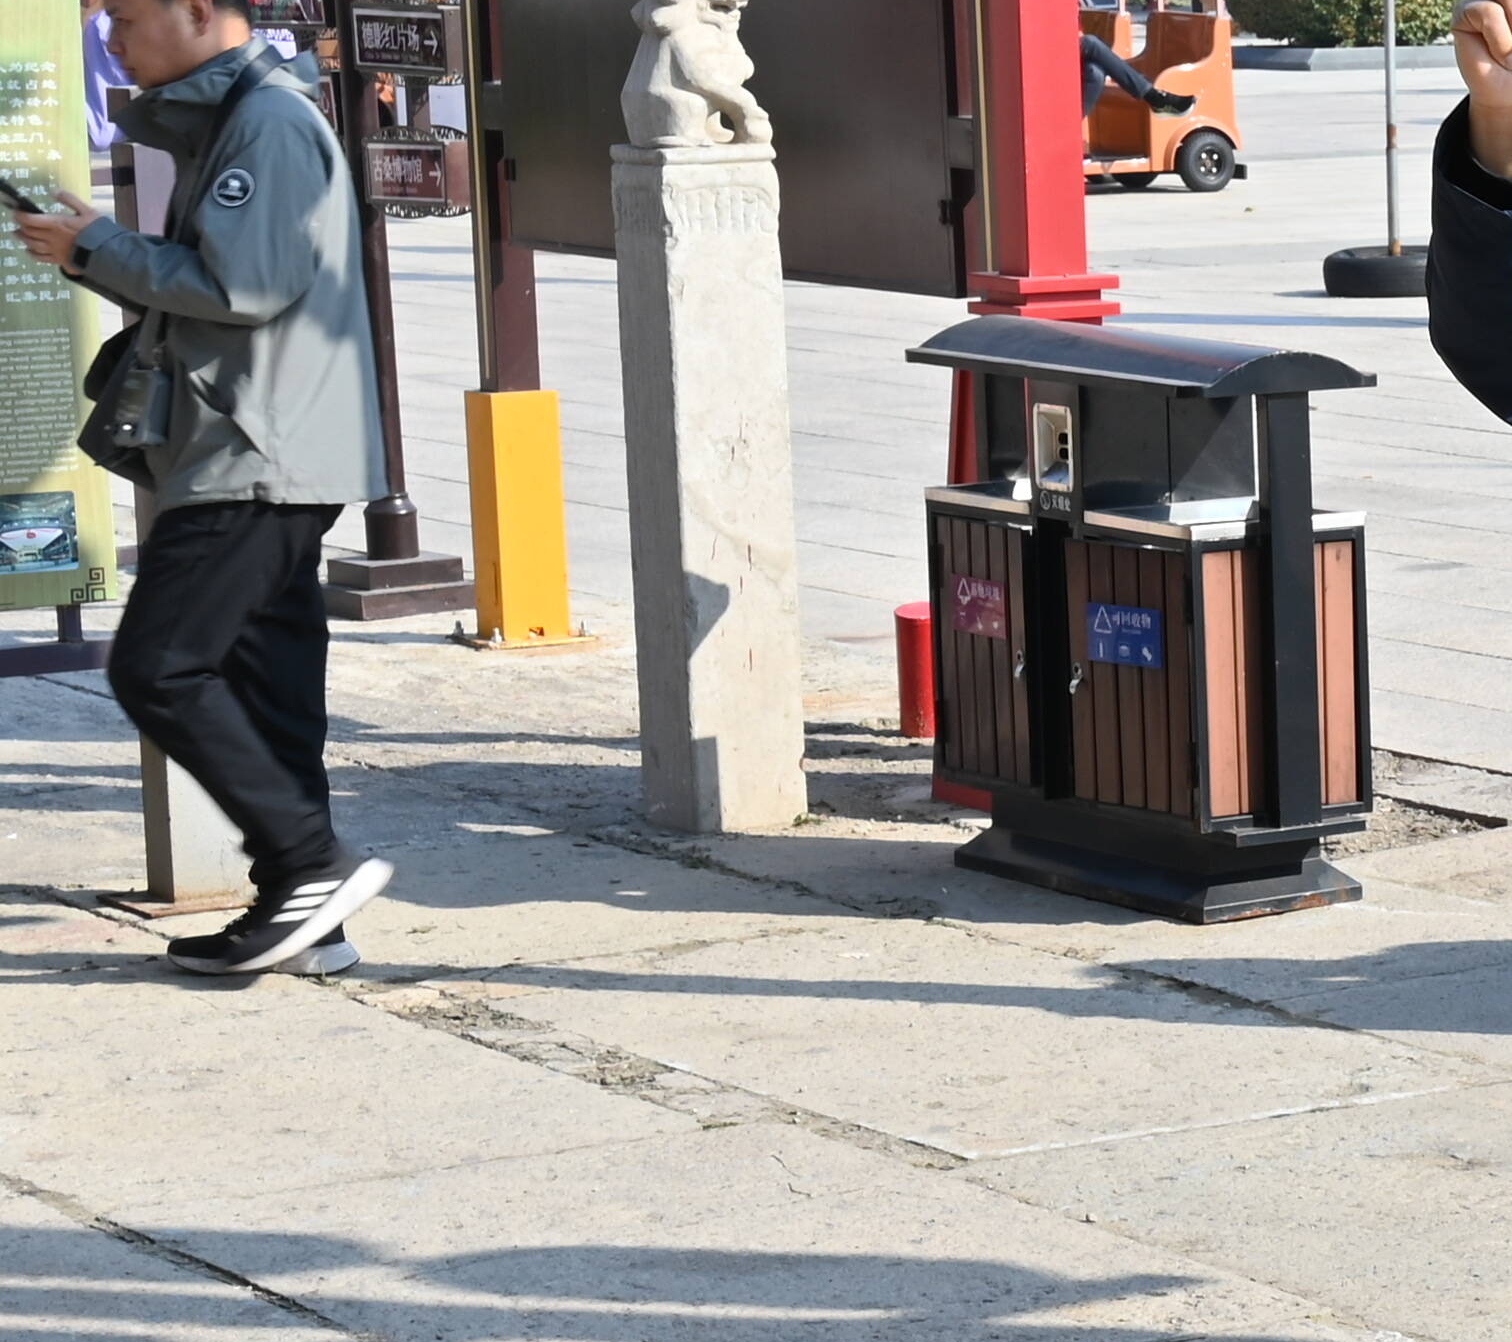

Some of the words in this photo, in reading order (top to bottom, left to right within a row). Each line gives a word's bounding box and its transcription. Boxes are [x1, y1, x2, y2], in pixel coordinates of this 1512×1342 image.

[373, 155, 423, 184] 古桑博物馆
[1111, 610, 1152, 630] 可回收物
